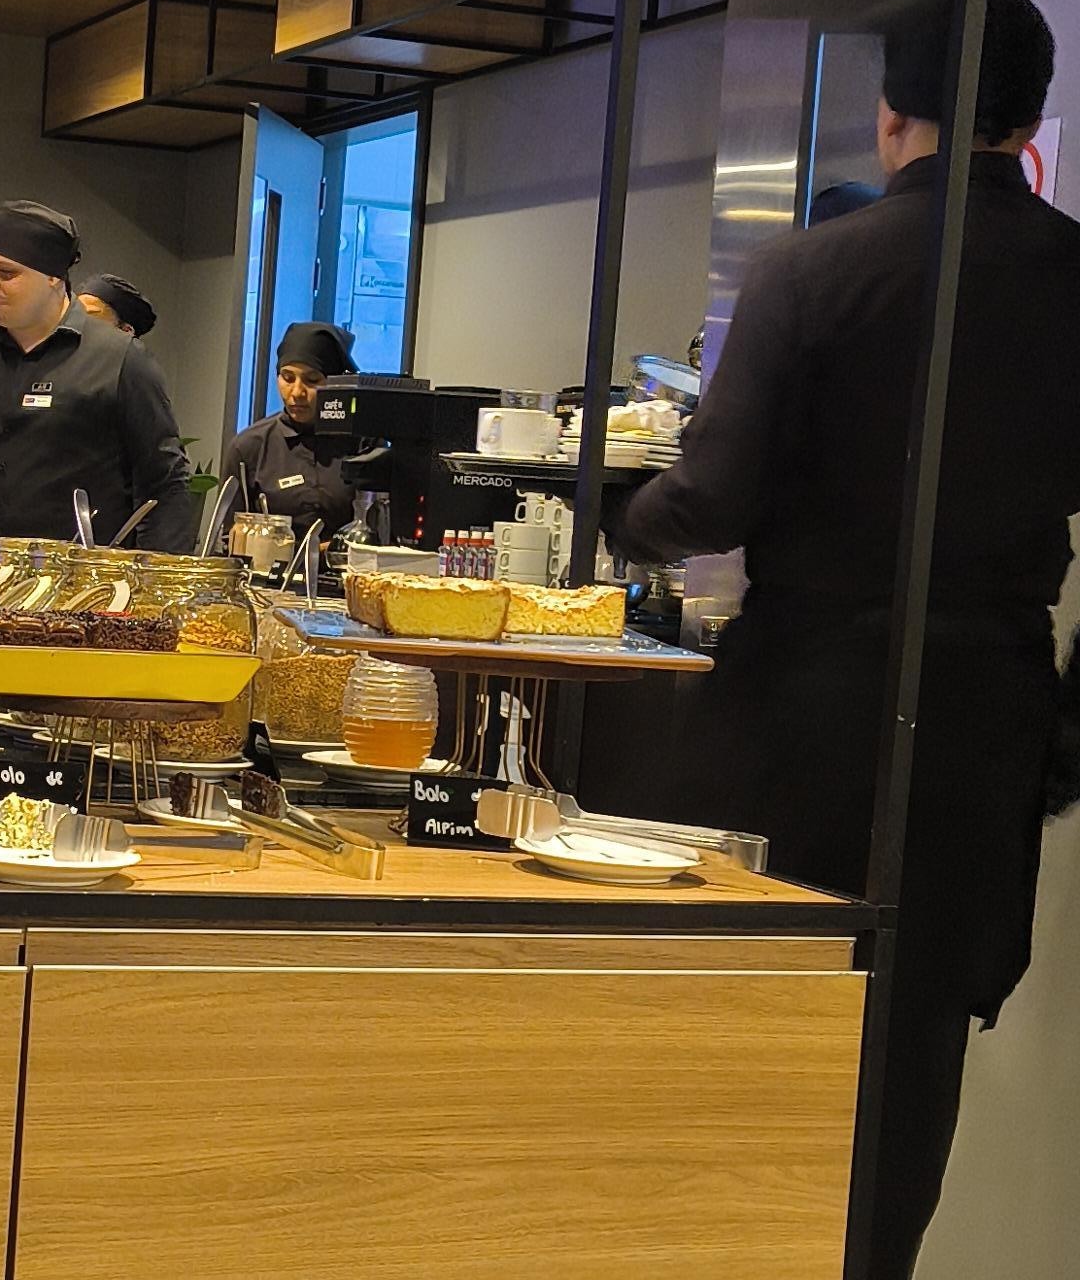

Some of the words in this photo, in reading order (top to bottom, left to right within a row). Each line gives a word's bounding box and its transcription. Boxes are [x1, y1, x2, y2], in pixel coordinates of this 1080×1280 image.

[320, 410, 345, 419] MERCADO
[453, 475, 513, 488] MERCADO
[46, 770, 63, 787] de
[414, 780, 450, 803] Bolo
